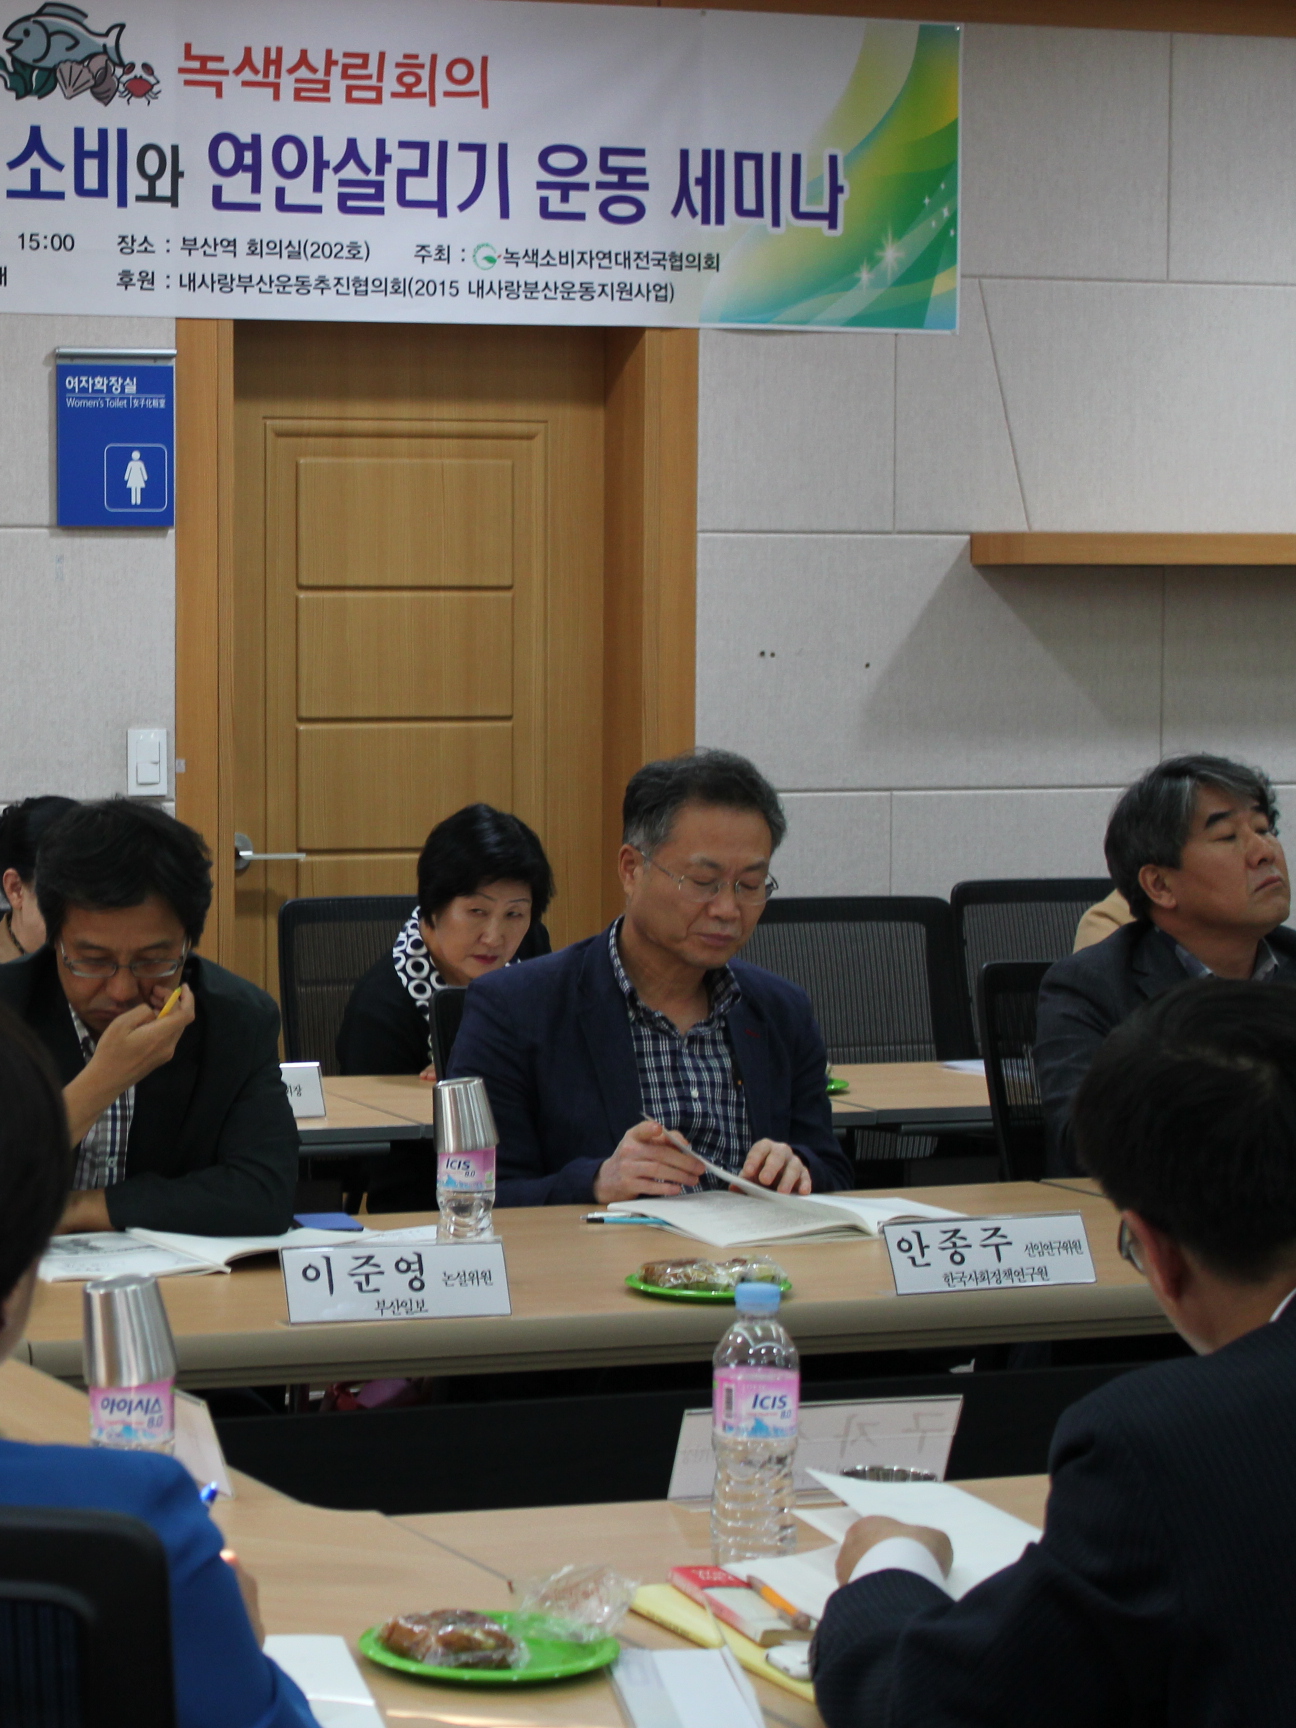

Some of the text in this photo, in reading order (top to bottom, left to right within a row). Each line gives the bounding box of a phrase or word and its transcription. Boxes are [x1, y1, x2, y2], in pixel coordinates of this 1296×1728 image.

[178, 43, 490, 109] 녹색살림회의
[6, 124, 184, 208] 소비와
[207, 130, 510, 219] 연안살리기
[534, 143, 648, 226] 운동
[670, 148, 845, 230] 세미나
[17, 231, 76, 253] 15:00
[179, 235, 237, 259] 부산역
[245, 237, 371, 263] 회의실(202호)
[503, 247, 721, 274] 녹색소비자연대전국협의회
[65, 375, 137, 394] 여자화장실
[66, 397, 127, 409] Women's Toilet
[301, 1252, 426, 1297] 이준영
[374, 1299, 429, 1316] 부산일보
